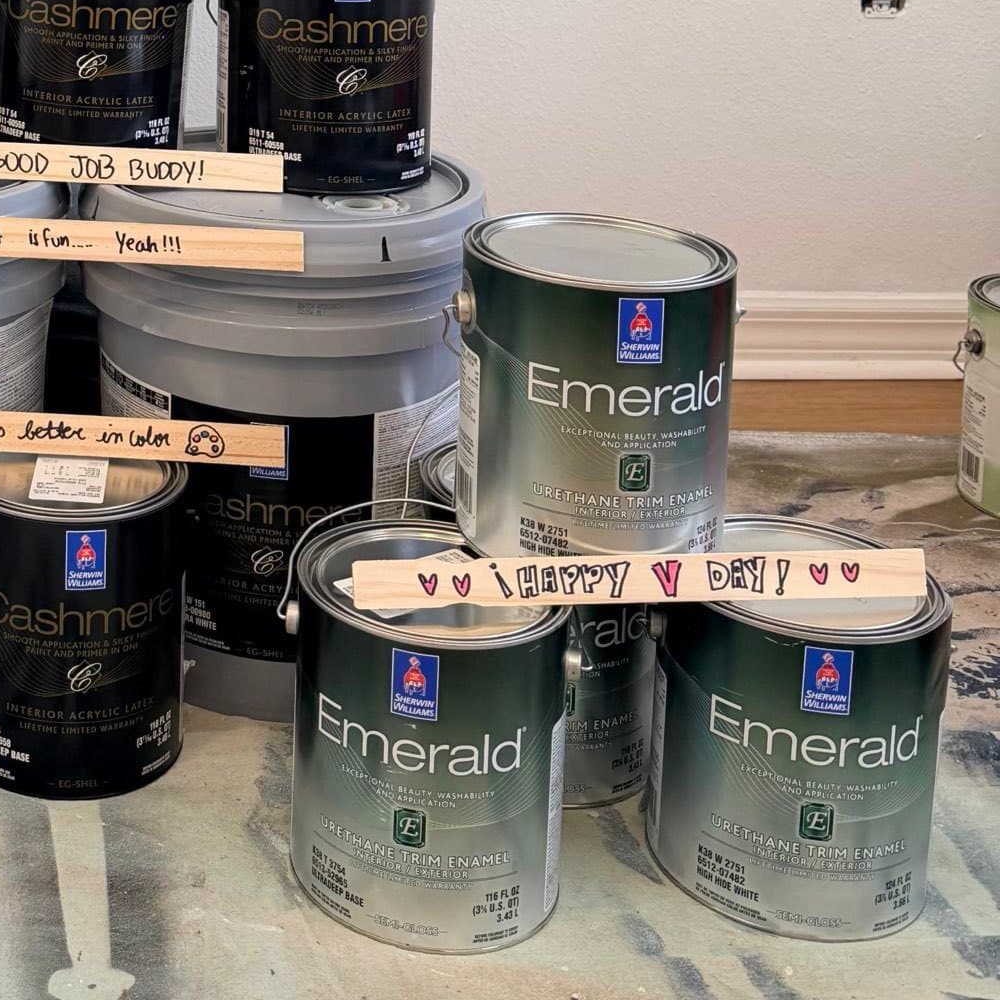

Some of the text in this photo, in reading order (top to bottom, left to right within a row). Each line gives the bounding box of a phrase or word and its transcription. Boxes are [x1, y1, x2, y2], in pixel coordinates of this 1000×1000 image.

[257, 8, 428, 43] Cashmere
[23, 88, 154, 105] INTERIOR ACRYLIC LATEX
[279, 108, 411, 120] INTERIOR ACRYLIC LATEX
[70, 154, 115, 179] JOB
[129, 159, 204, 183] BUDDY!
[328, 176, 363, 184] EG-SHEL
[116, 230, 182, 253] Yeah!!!
[620, 350, 659, 360] WILLIAMS
[622, 342, 659, 351] SHERWIN
[528, 362, 724, 417] Emerald
[18, 420, 86, 441] better
[96, 424, 124, 443] in
[561, 426, 621, 440] EXCEPTIONAL
[661, 425, 706, 439] WASHABILITY
[624, 440, 677, 449] APPLICATION
[252, 468, 286, 477] WILLIAMS
[626, 463, 645, 481] E
[533, 482, 713, 508] URETHANE TRIM ENAMEL
[206, 494, 361, 526] ashmere
[575, 507, 627, 518] INTERIOR
[640, 507, 685, 518] EXTERIOR
[520, 517, 568, 537] K38 W 2751
[520, 529, 568, 548] 6512-07482
[520, 539, 555, 555] HIGH HIDE
[68, 578, 103, 587] WILLIAMS
[69, 570, 103, 579] SHERWIN
[706, 556, 790, 596] DAY!
[195, 617, 217, 631] WHITE
[581, 603, 648, 648] rald
[395, 693, 434, 707] SHERWIN
[804, 698, 846, 712] WILLIAMS
[805, 690, 846, 702] SHERWIN
[6, 698, 152, 720] INTERIOR ACRYLIC LATEX
[393, 702, 434, 717] WILLIAMS
[318, 692, 523, 776] Emerald
[710, 693, 922, 768] Emerald
[11, 751, 30, 763] BASE
[342, 764, 394, 792] EXCEPTIONAL
[437, 790, 495, 800] WASHABILITY
[741, 764, 802, 787] EXCEPTIONAL
[846, 780, 898, 792] WASHABILITY
[376, 788, 456, 808] AND APPLICATION
[781, 785, 864, 800] AND APPLICATION
[400, 817, 419, 836] E
[807, 812, 827, 830] E
[320, 815, 511, 869] URETHANE TRIM ENAMEL
[711, 813, 905, 860] URETHANE TRIM ENAMEL
[353, 848, 402, 871] INTERIOR
[415, 868, 469, 879] EXTERIOR
[698, 844, 745, 874] K38 W 2751
[697, 856, 745, 886] 6512-07482
[312, 866, 344, 897] ULTRADEEP
[345, 891, 364, 908] BASE
[485, 885, 519, 901] 116 FL OZ
[697, 868, 760, 901] HIGH HIDE WHITE
[374, 912, 440, 936] SEMI-GLOSS
[776, 910, 842, 927] SEMI-GLOSS
